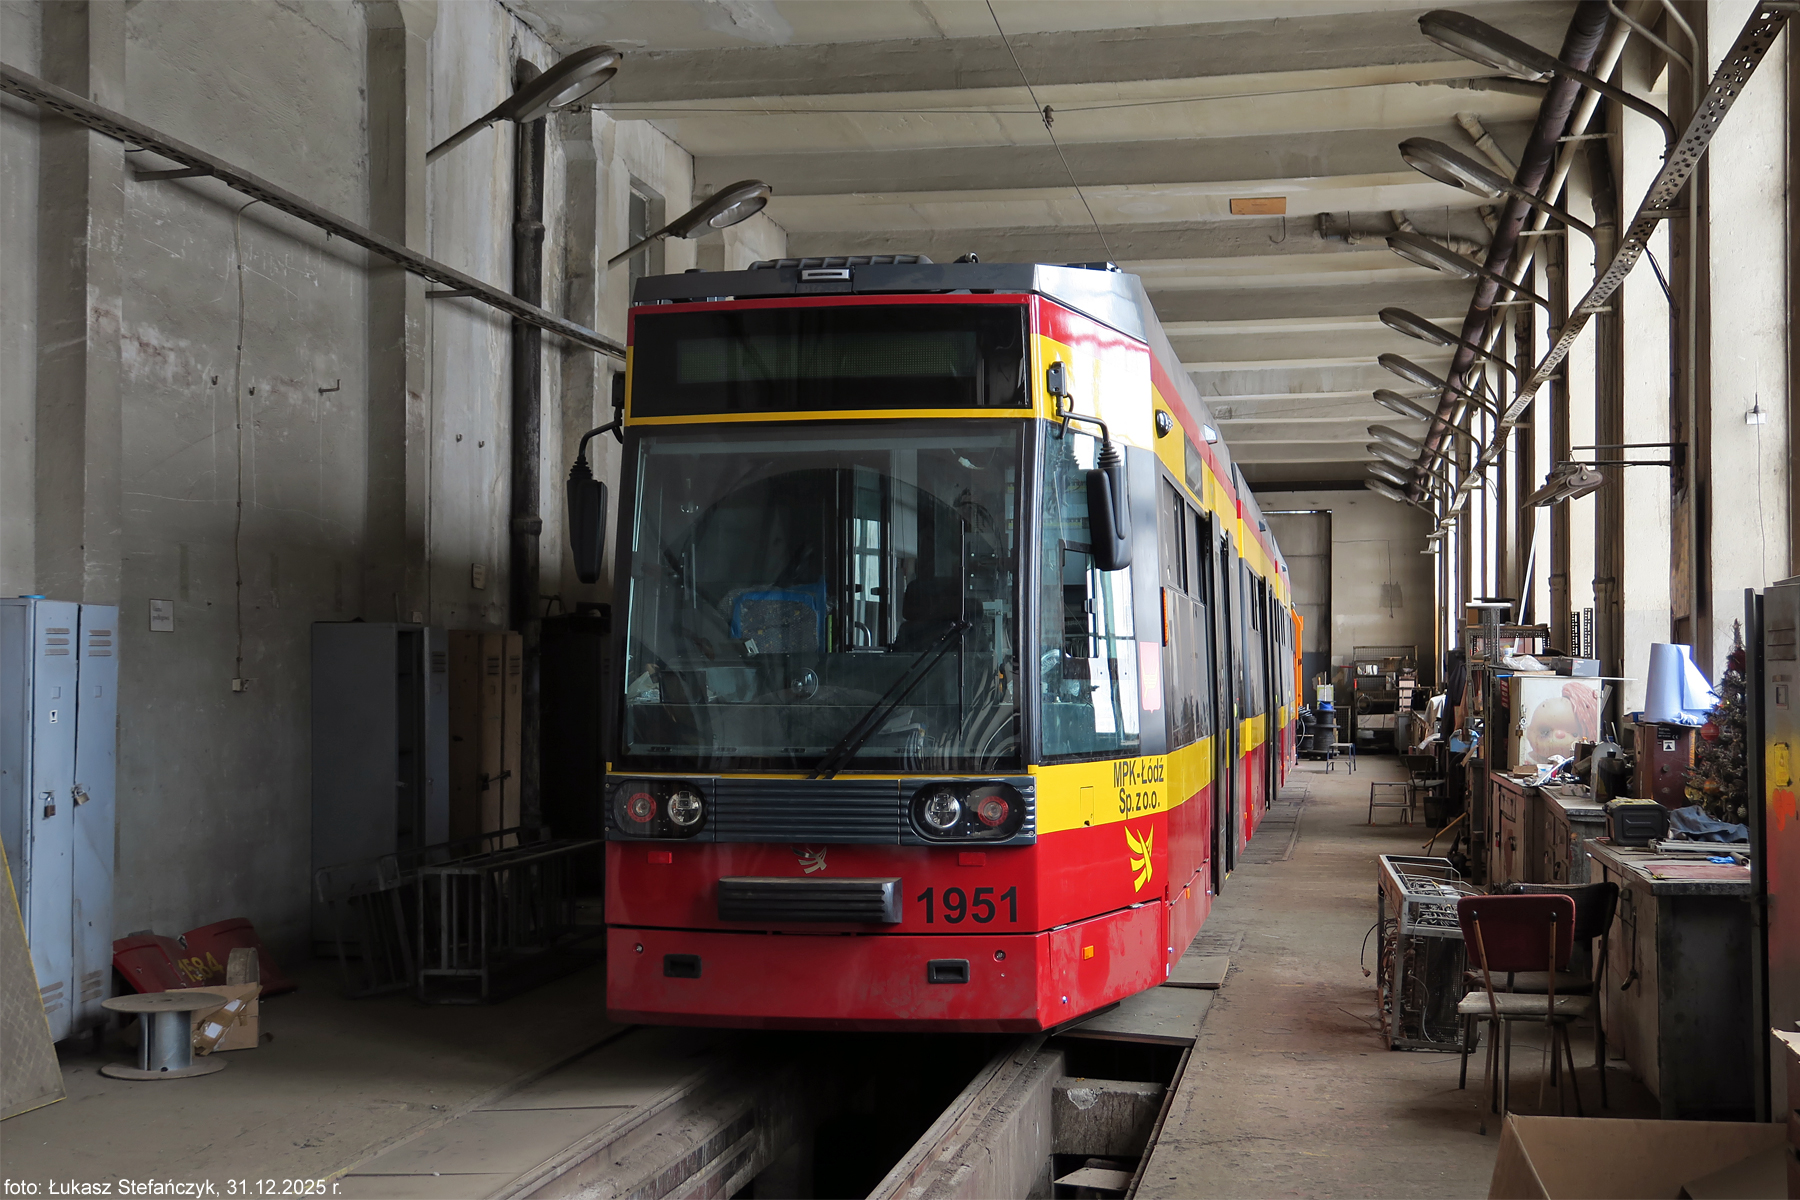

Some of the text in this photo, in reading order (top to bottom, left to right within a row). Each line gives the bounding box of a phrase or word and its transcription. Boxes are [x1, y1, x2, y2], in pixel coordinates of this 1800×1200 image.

[1113, 757, 1164, 788] MPK-Łódź
[916, 886, 1018, 924] 1951
[177, 951, 225, 983] 1584
